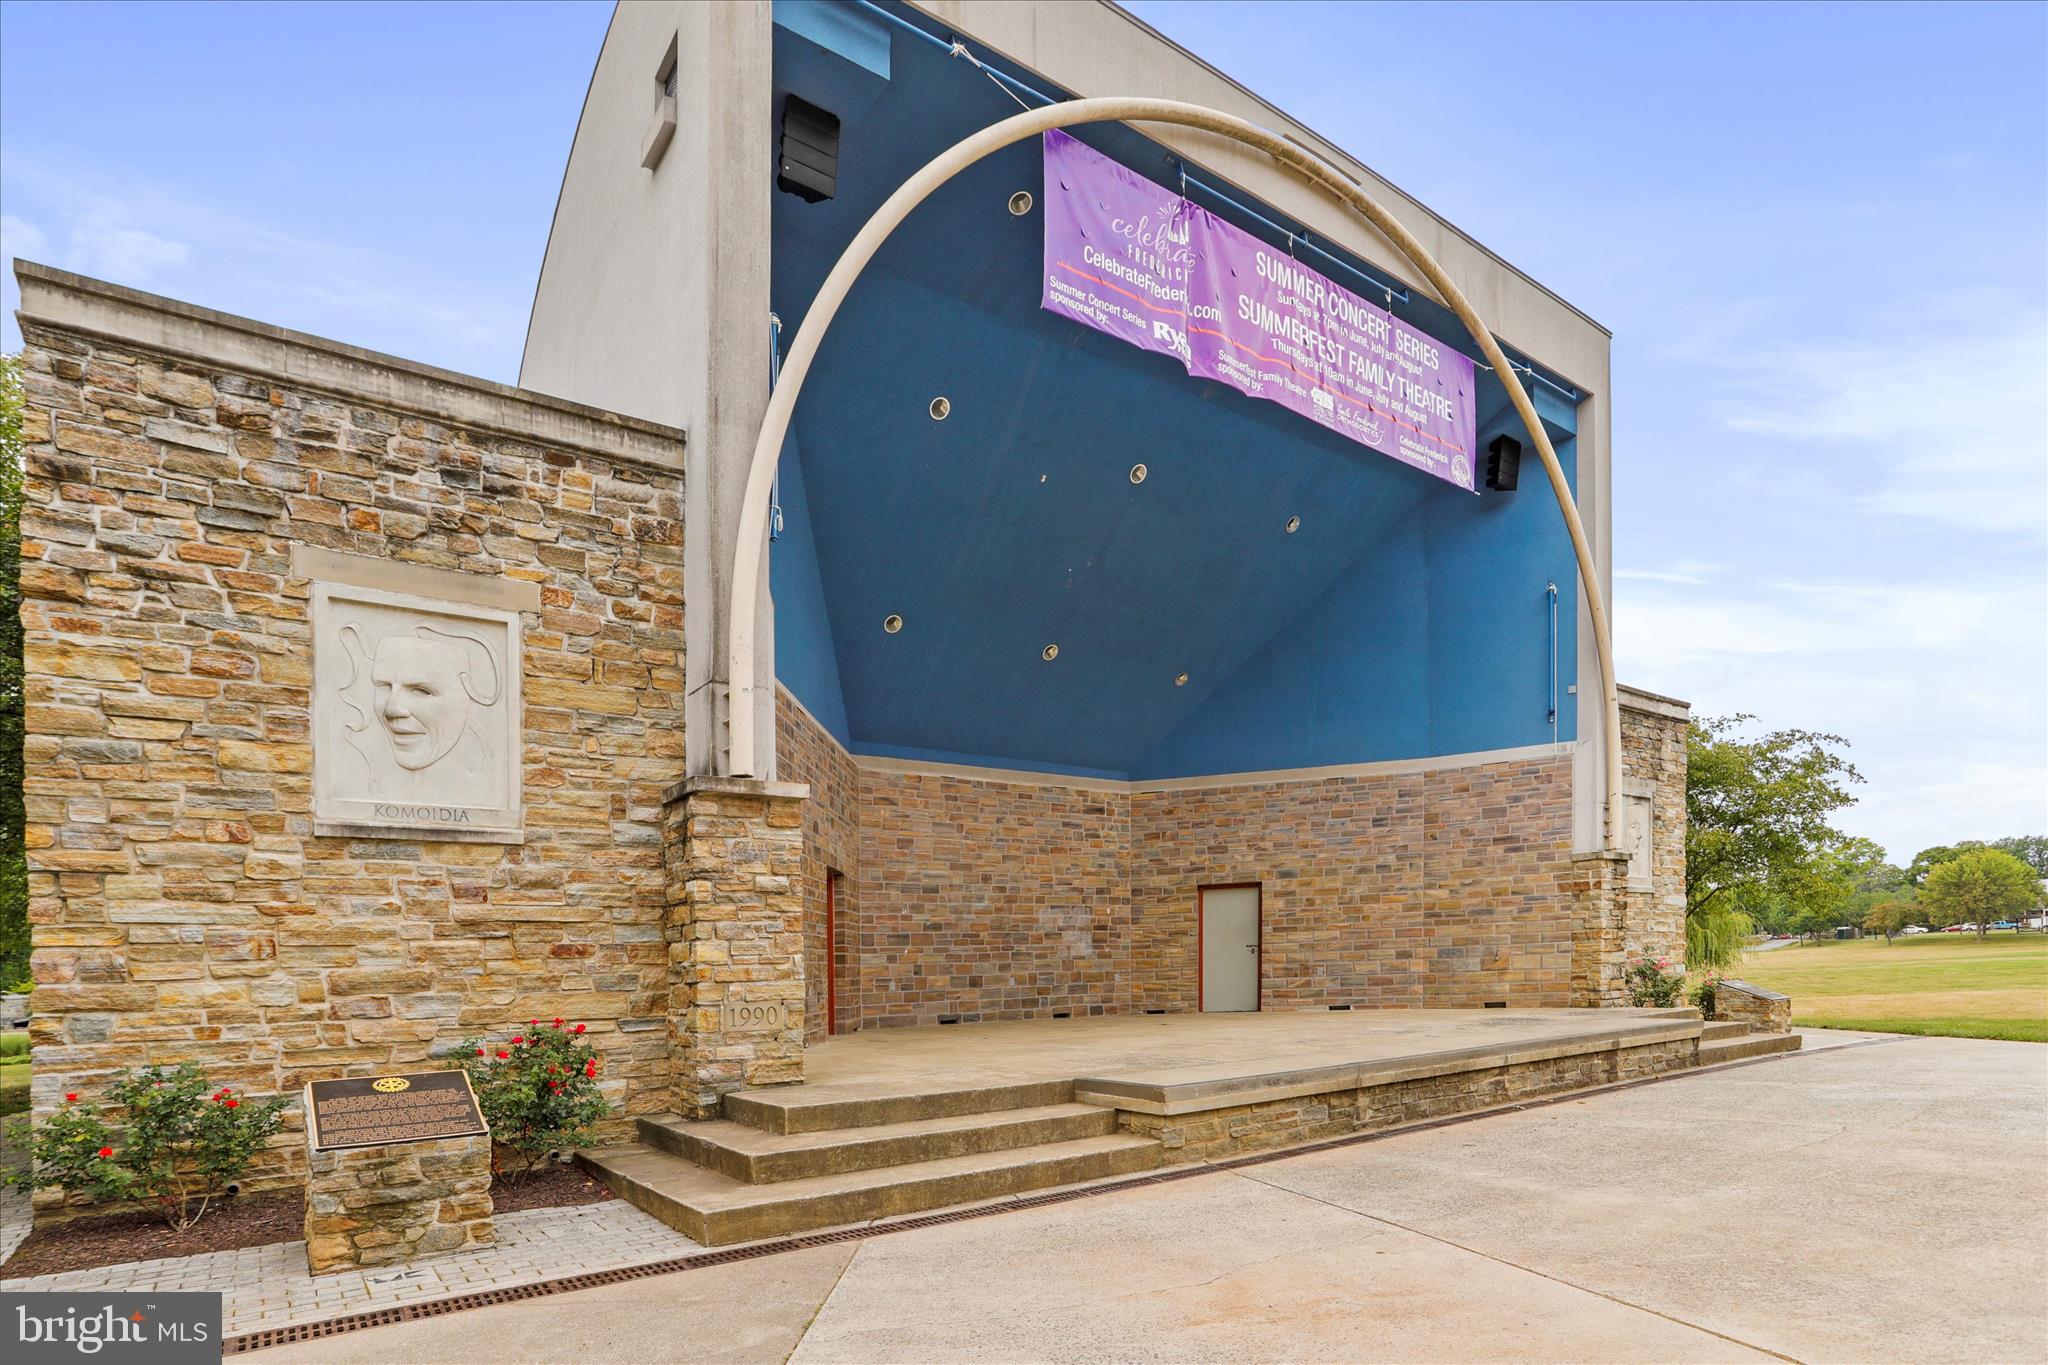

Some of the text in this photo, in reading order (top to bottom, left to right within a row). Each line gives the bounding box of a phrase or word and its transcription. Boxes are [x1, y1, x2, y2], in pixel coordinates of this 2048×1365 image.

[1050, 276, 1147, 329] Summer Concert Series
[1050, 290, 1109, 324] sponsored by:
[1256, 251, 1439, 370] SUMMER CONCERT SERIES
[1349, 328, 1369, 349] June,
[1238, 294, 1345, 367] SUMMERFEST
[1348, 350, 1395, 393] FAMILY
[1398, 376, 1453, 421] THEATRE
[1270, 338, 1314, 368] Thursdays
[1314, 360, 1322, 373] at
[1324, 365, 1346, 384] 10am
[1346, 375, 1354, 388] in
[1258, 368, 1284, 387] Family
[374, 804, 471, 823] KOMOIDIA
[730, 1006, 778, 1028] 1990
